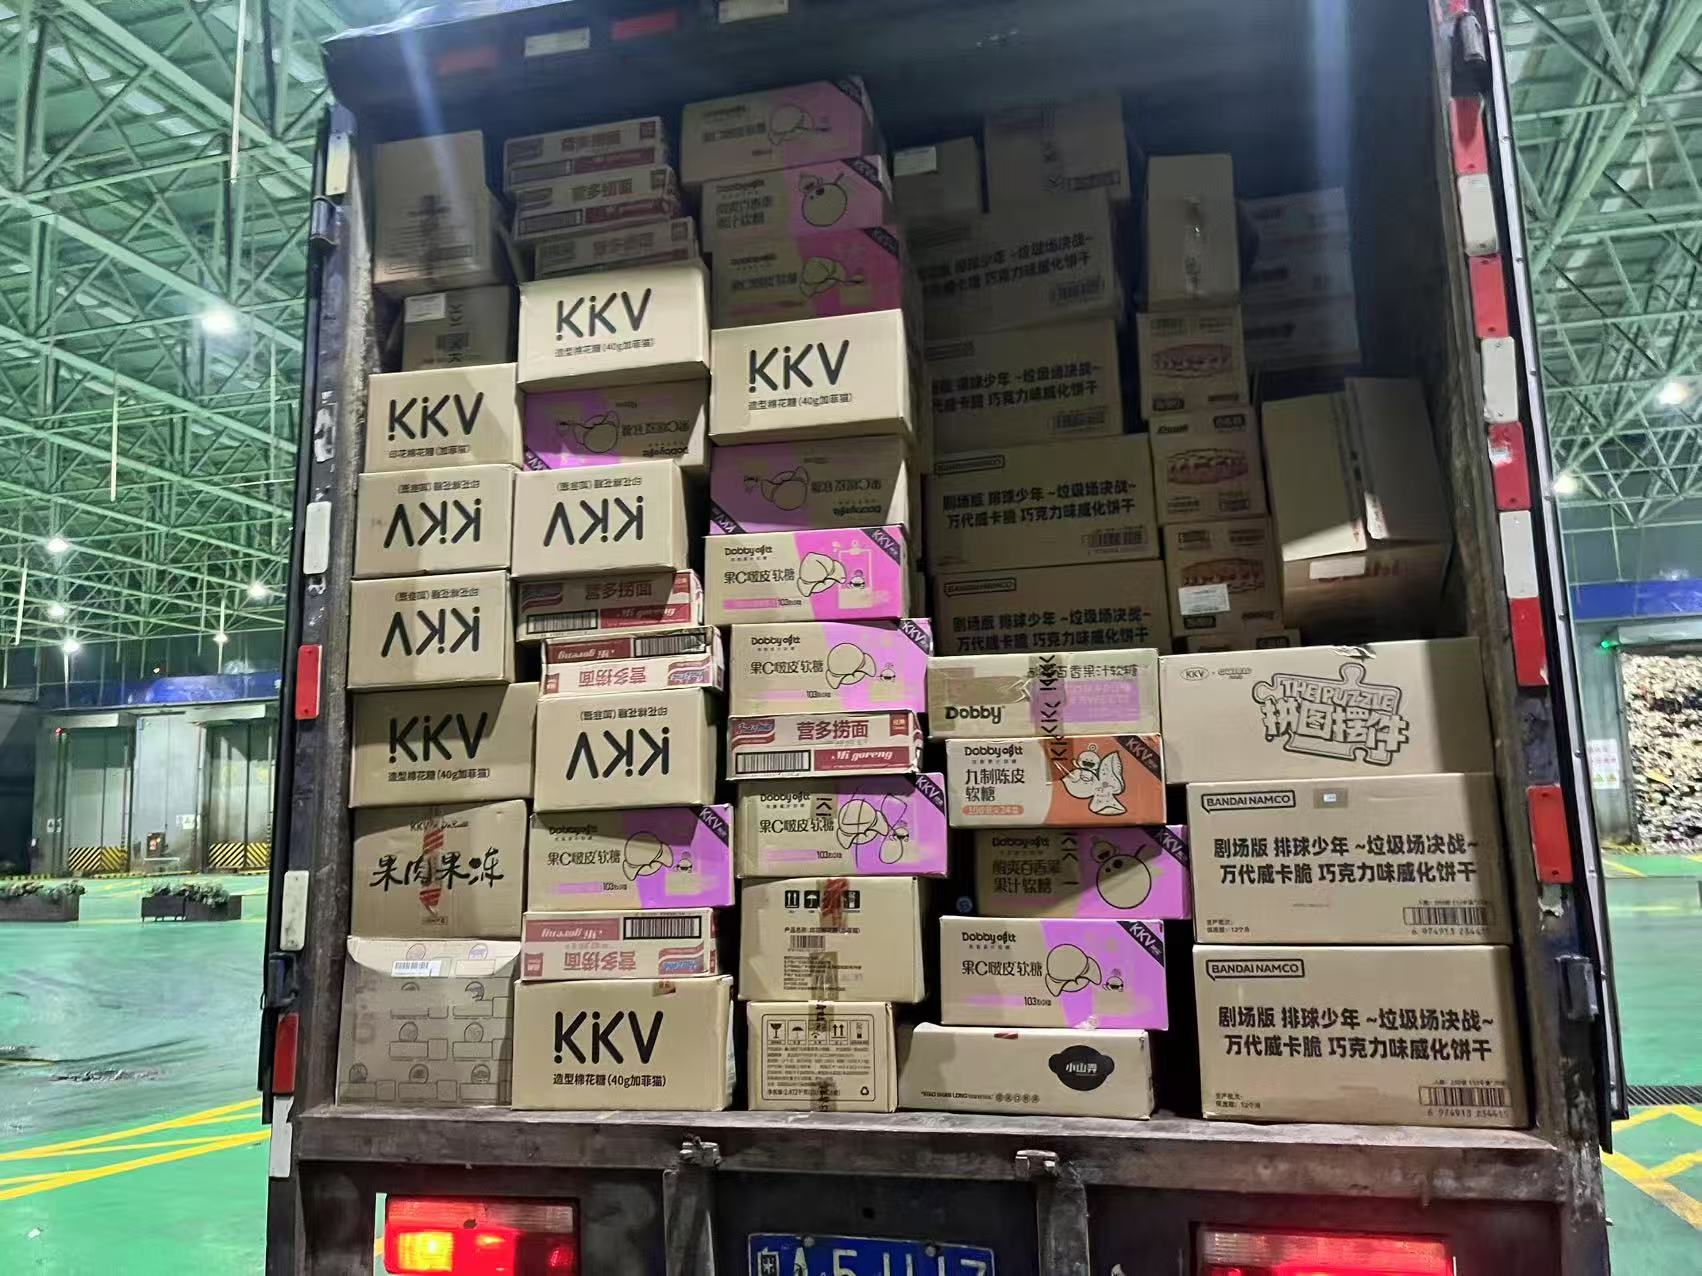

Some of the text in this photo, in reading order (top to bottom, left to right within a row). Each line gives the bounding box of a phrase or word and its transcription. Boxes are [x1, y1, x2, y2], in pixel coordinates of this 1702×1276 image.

[1281, 678, 1397, 713] THE PUZZLE
[945, 705, 1002, 724] Dobby
[796, 719, 870, 741] 营多捞面
[964, 768, 1026, 786] 九制陈皮
[964, 786, 996, 803] 软糖
[1214, 837, 1269, 859] 剧场版
[1273, 835, 1350, 859] 排球少年
[369, 846, 505, 892] 果肉果冻
[1219, 860, 1477, 885] 万代威卡脆 巧克力味威化饼干
[1211, 963, 1299, 974] BANDAI NAMCO
[1218, 1006, 1277, 1028] 剧场版
[1281, 1007, 1360, 1030] 排球少年
[1224, 1034, 1492, 1061] 万代威卡脆 巧克力味威化饼干
